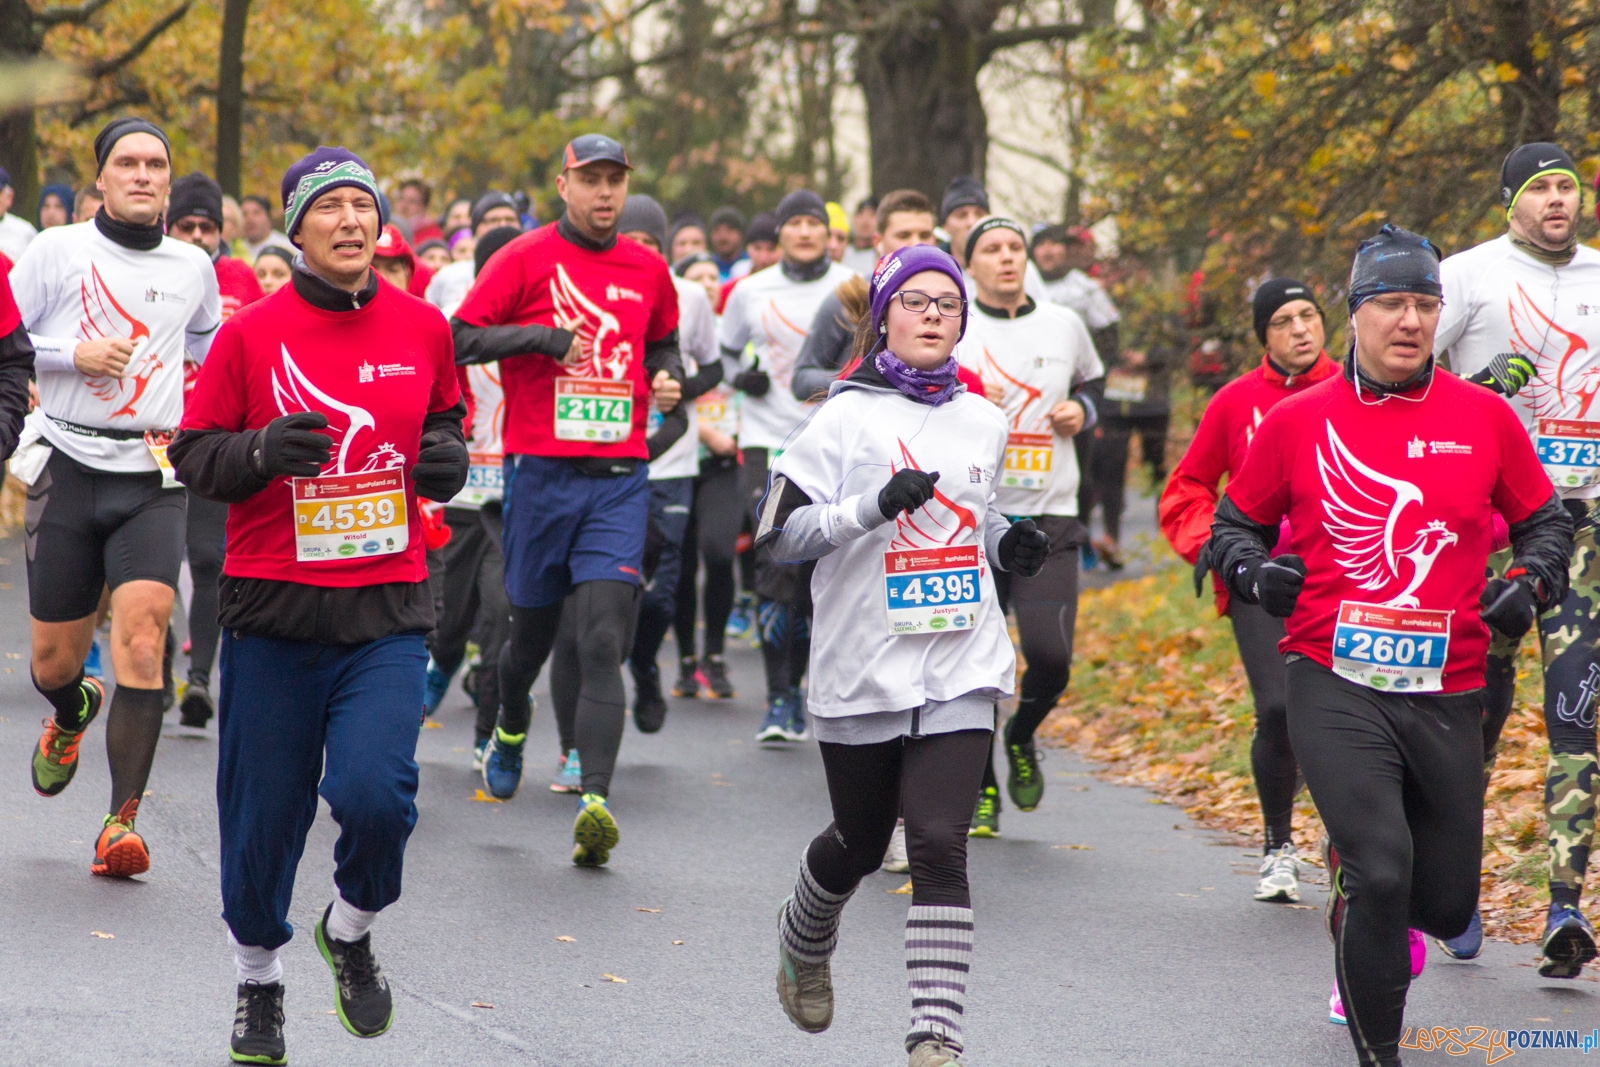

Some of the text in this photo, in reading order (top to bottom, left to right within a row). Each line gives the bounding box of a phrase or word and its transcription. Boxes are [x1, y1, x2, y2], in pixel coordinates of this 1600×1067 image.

[377, 364, 386, 377] 1
[567, 398, 625, 421] 2174
[1429, 440, 1438, 454] 1
[1538, 447, 1546, 455] E
[1007, 450, 1047, 469] 111
[356, 478, 397, 489] RunPoland.org
[298, 498, 396, 531] D 4539
[343, 533, 367, 541] Witold
[944, 555, 975, 563] RunPoland.org
[890, 573, 975, 604] E 4395
[932, 607, 959, 615] Justyna
[1401, 619, 1442, 629] RunPoland.org
[1337, 632, 1433, 665] E 2601
[1338, 665, 1357, 674] GRUPA
[1375, 667, 1403, 676] Andrzej
